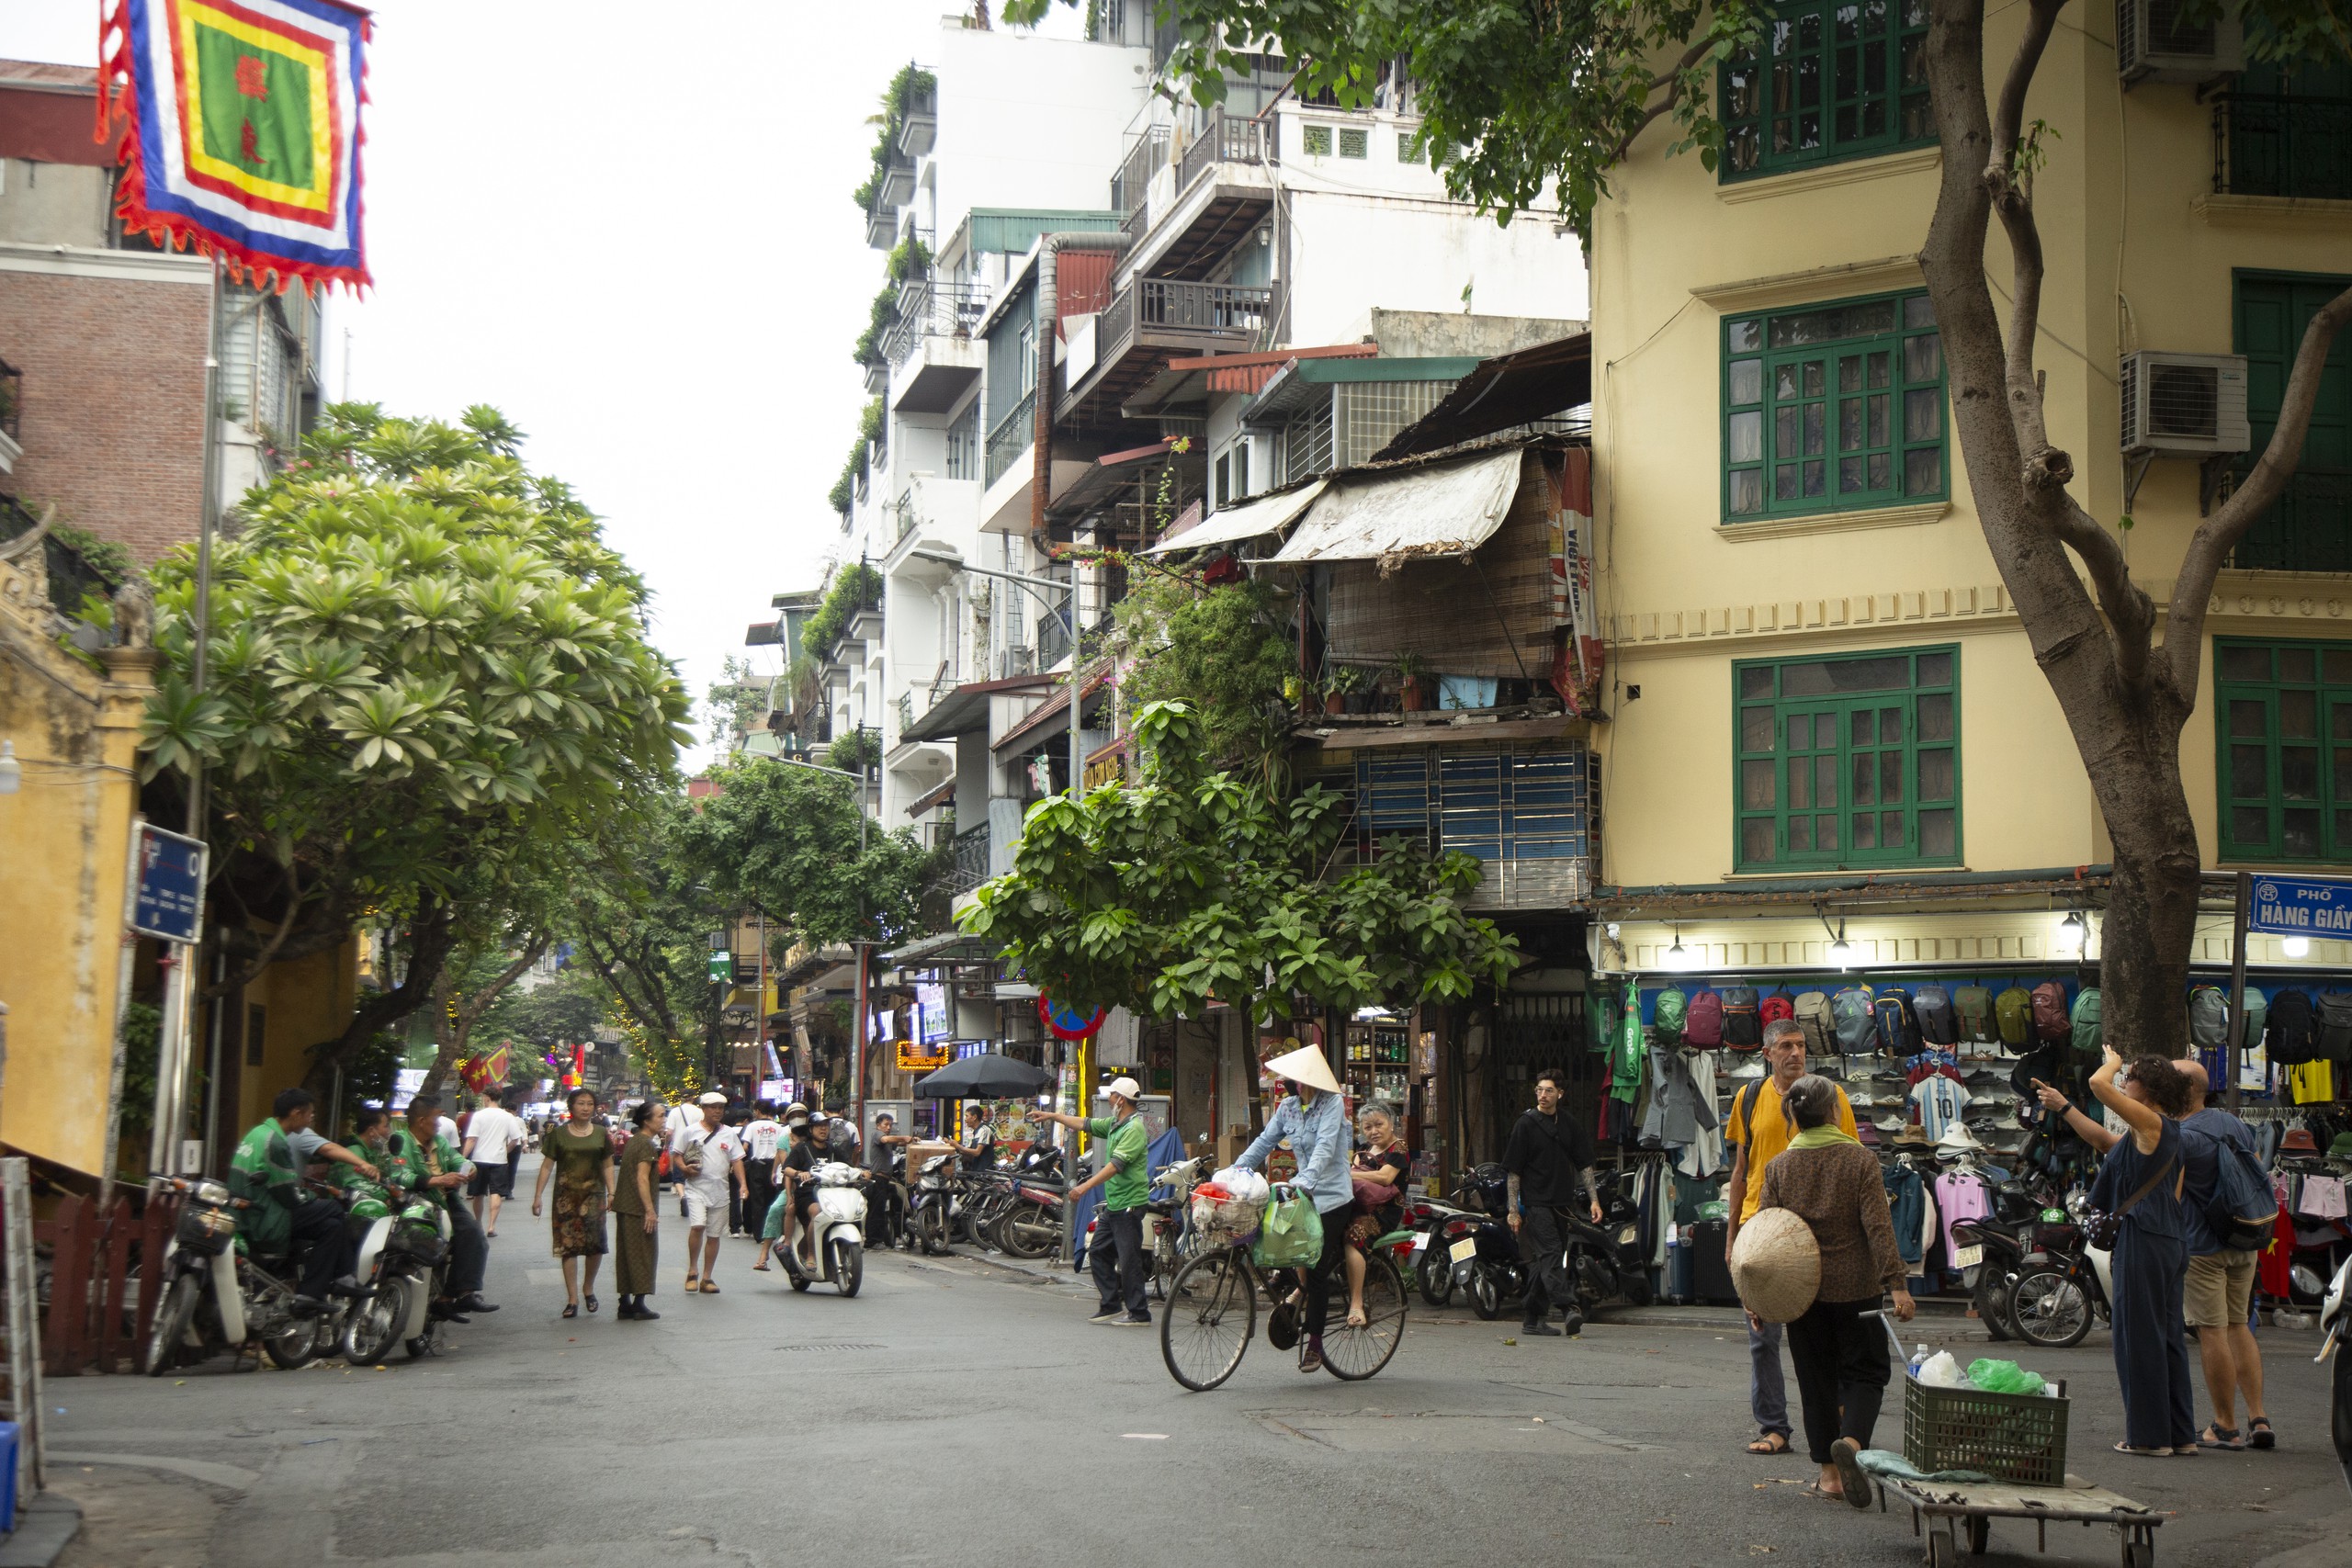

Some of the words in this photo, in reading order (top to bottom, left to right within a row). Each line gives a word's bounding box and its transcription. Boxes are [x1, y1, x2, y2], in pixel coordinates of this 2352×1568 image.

[2297, 887, 2334, 901] PHỐ
[2260, 900, 2310, 927] HÀNG
[2315, 904, 2352, 931] GIẦY
[1626, 1027, 1634, 1055] Grab
[1935, 1098, 1953, 1120] 10
